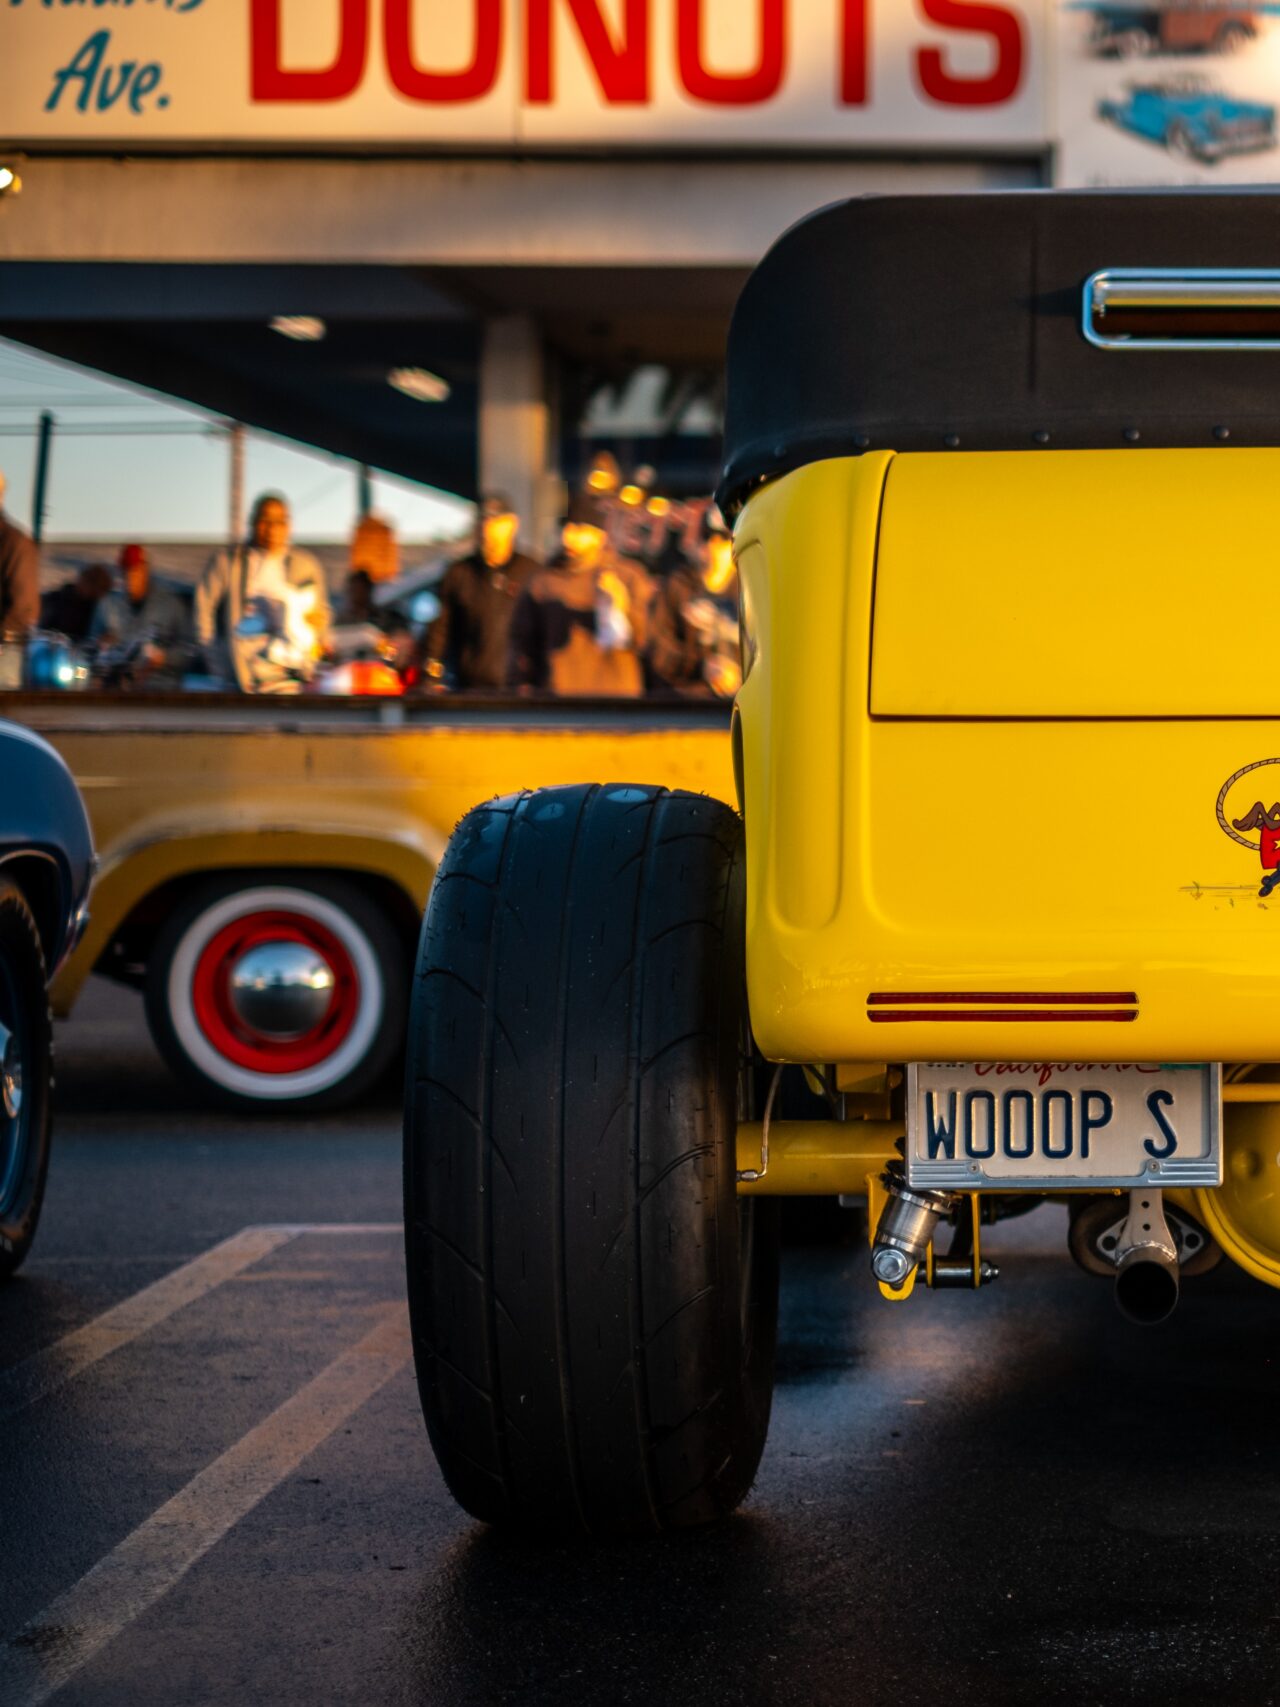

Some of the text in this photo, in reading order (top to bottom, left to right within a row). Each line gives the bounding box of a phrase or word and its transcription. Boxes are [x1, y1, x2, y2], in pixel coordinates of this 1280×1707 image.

[45, 28, 170, 114] Ave.
[926, 1090, 1178, 1159] WOOOP S
